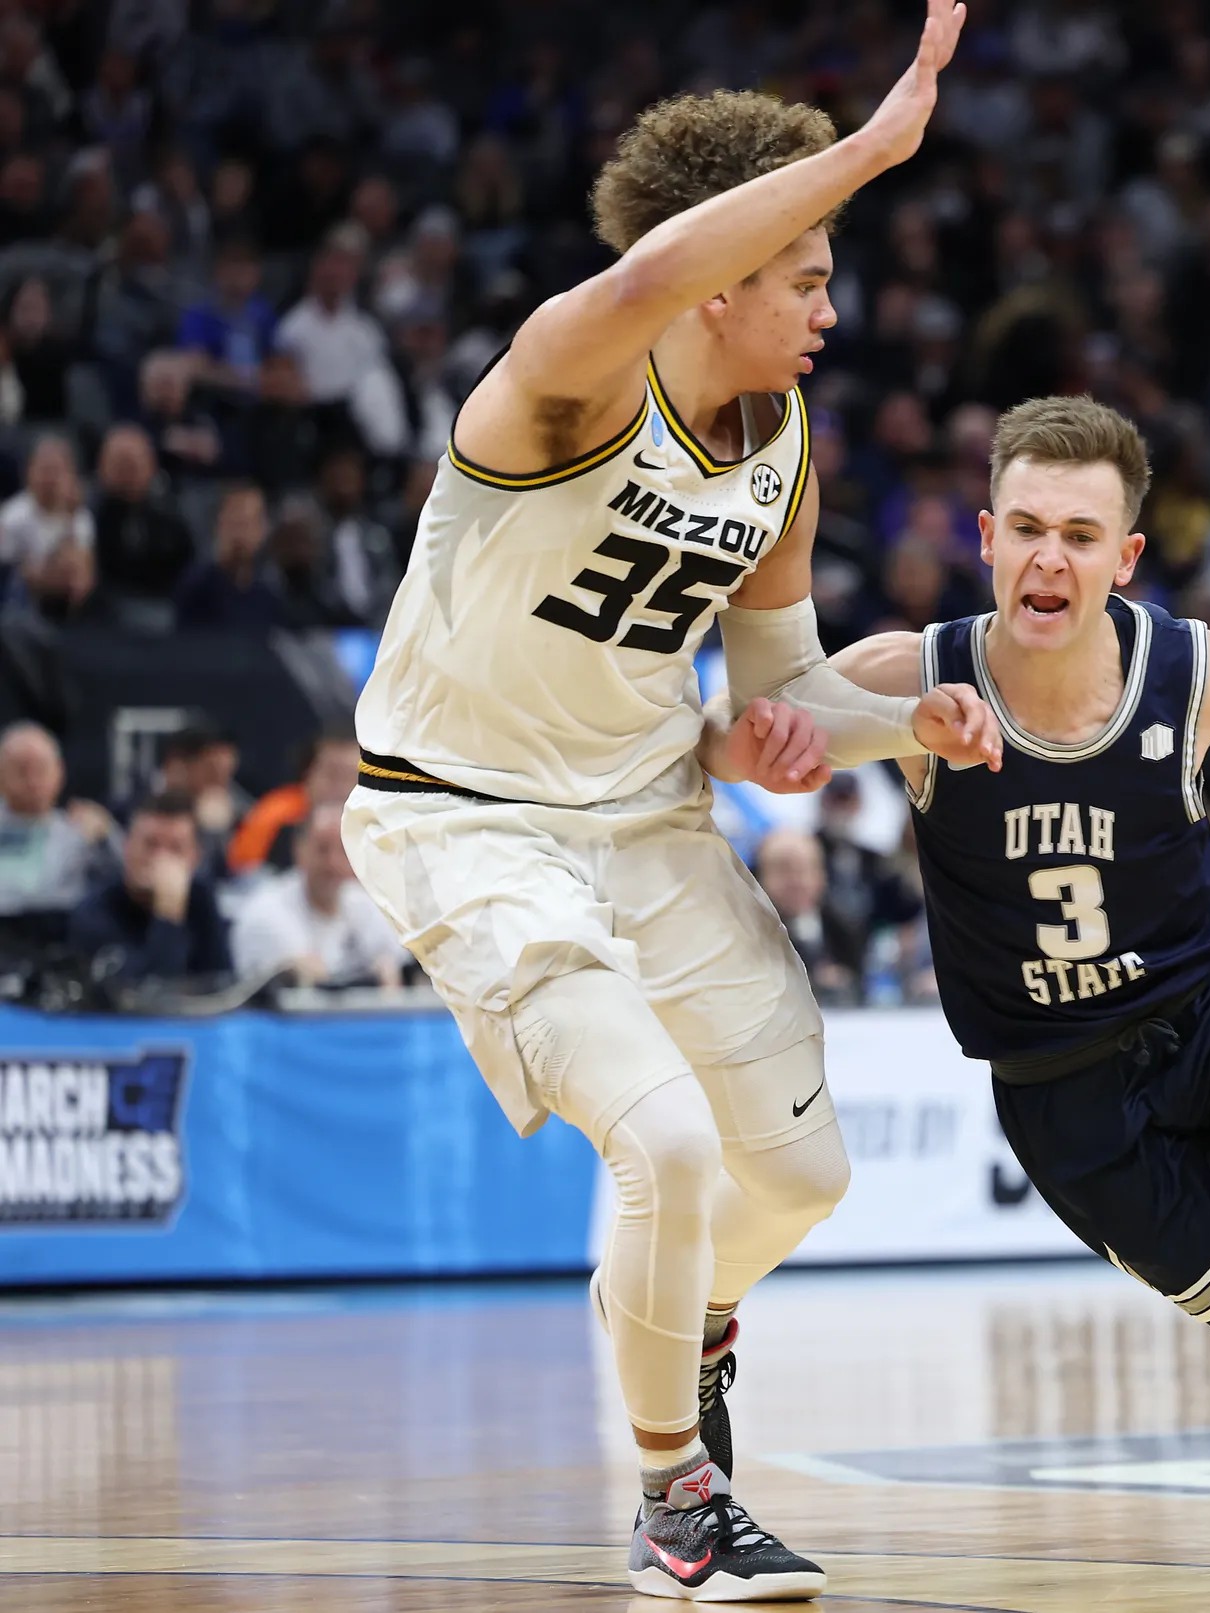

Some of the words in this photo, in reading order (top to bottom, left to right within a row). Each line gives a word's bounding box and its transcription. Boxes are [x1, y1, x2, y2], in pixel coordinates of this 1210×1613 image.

[751, 465, 781, 504] SEC
[607, 479, 768, 561] MIZZOU
[531, 533, 749, 654] 35
[1004, 802, 1116, 861] UTAH
[1027, 864, 1111, 960] 3
[1021, 951, 1147, 1006] STATE
[0, 1065, 108, 1132] ARCH
